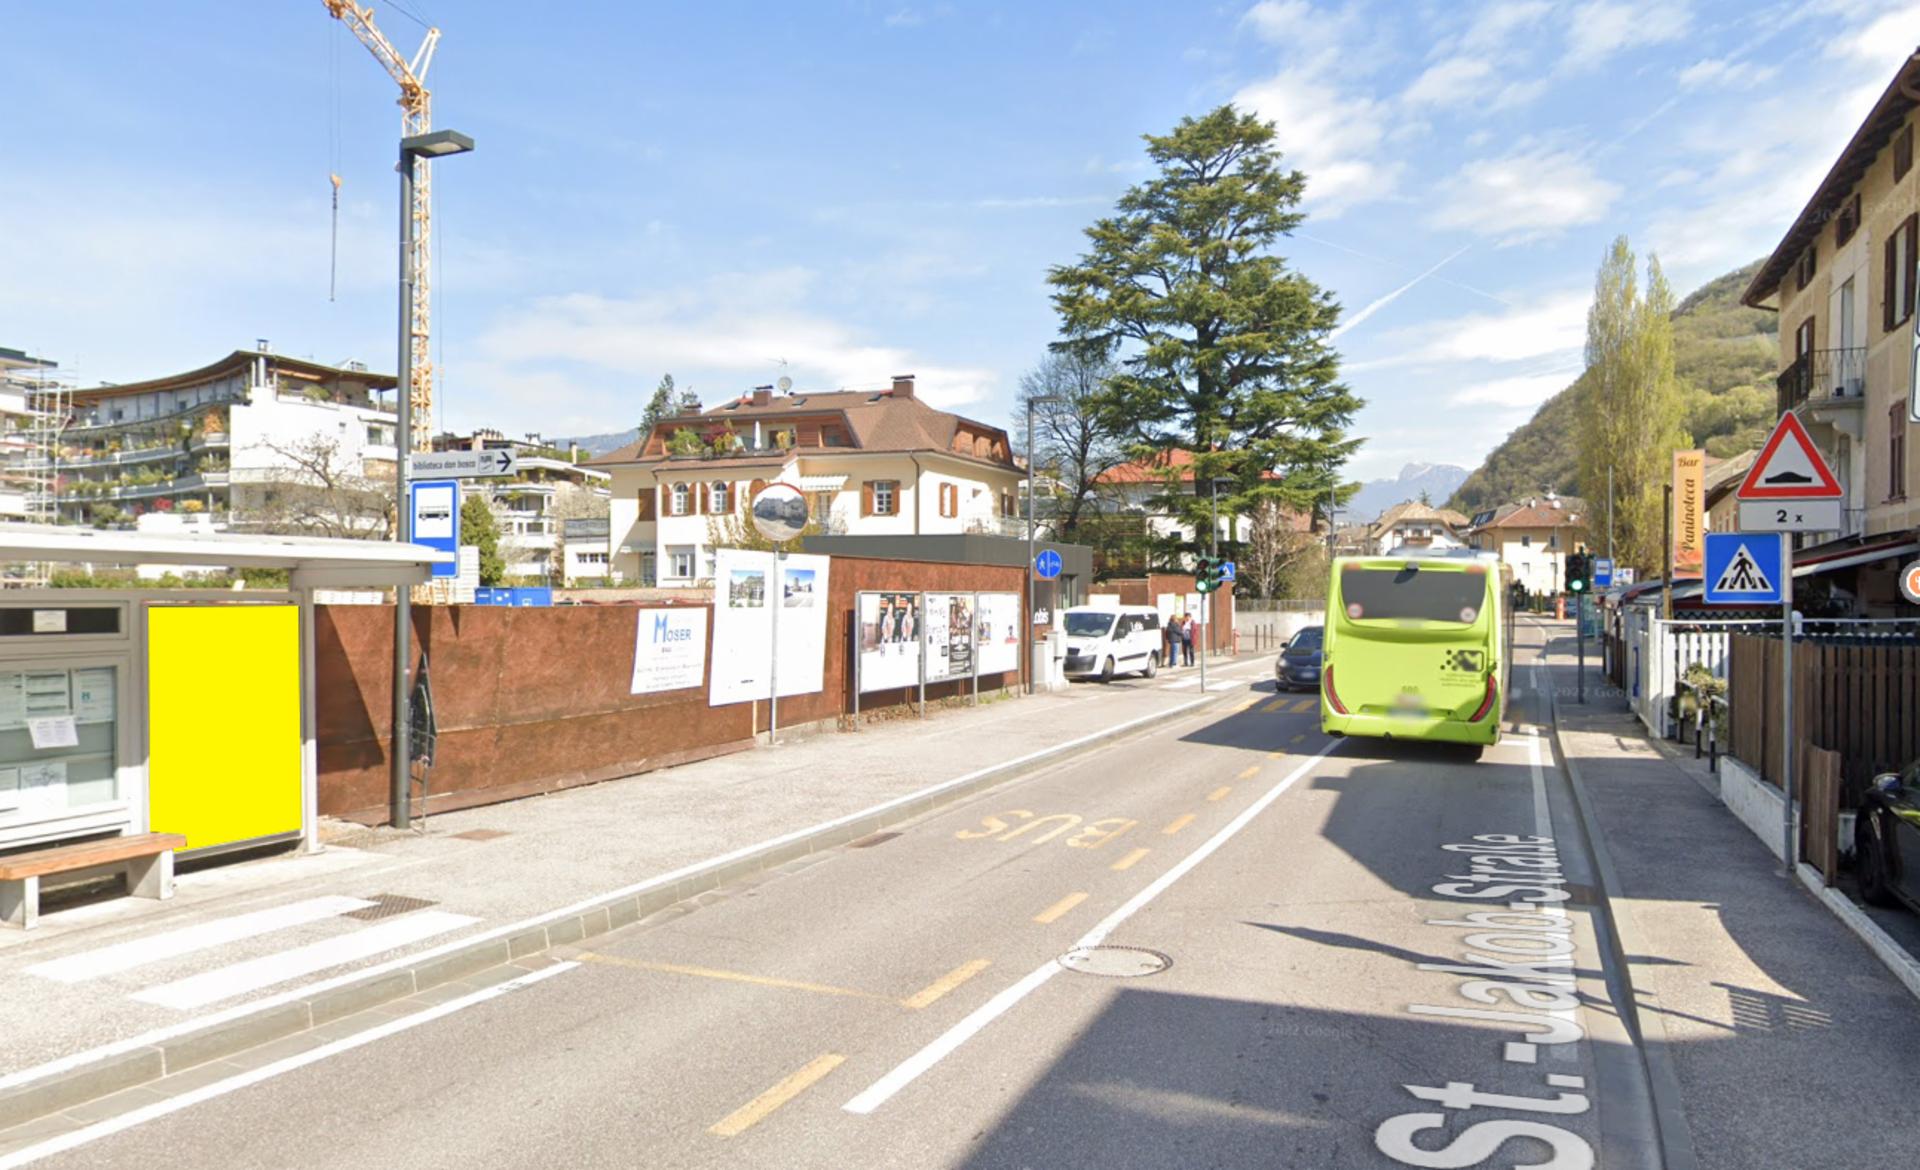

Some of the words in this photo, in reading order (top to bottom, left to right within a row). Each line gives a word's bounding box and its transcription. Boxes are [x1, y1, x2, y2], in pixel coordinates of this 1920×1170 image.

[1678, 457, 1699, 468] Bar
[1682, 478, 1696, 552] Paninoteca
[1776, 509, 1788, 523] 2
[1795, 514, 1803, 523] x
[954, 809, 1140, 849] BUS
